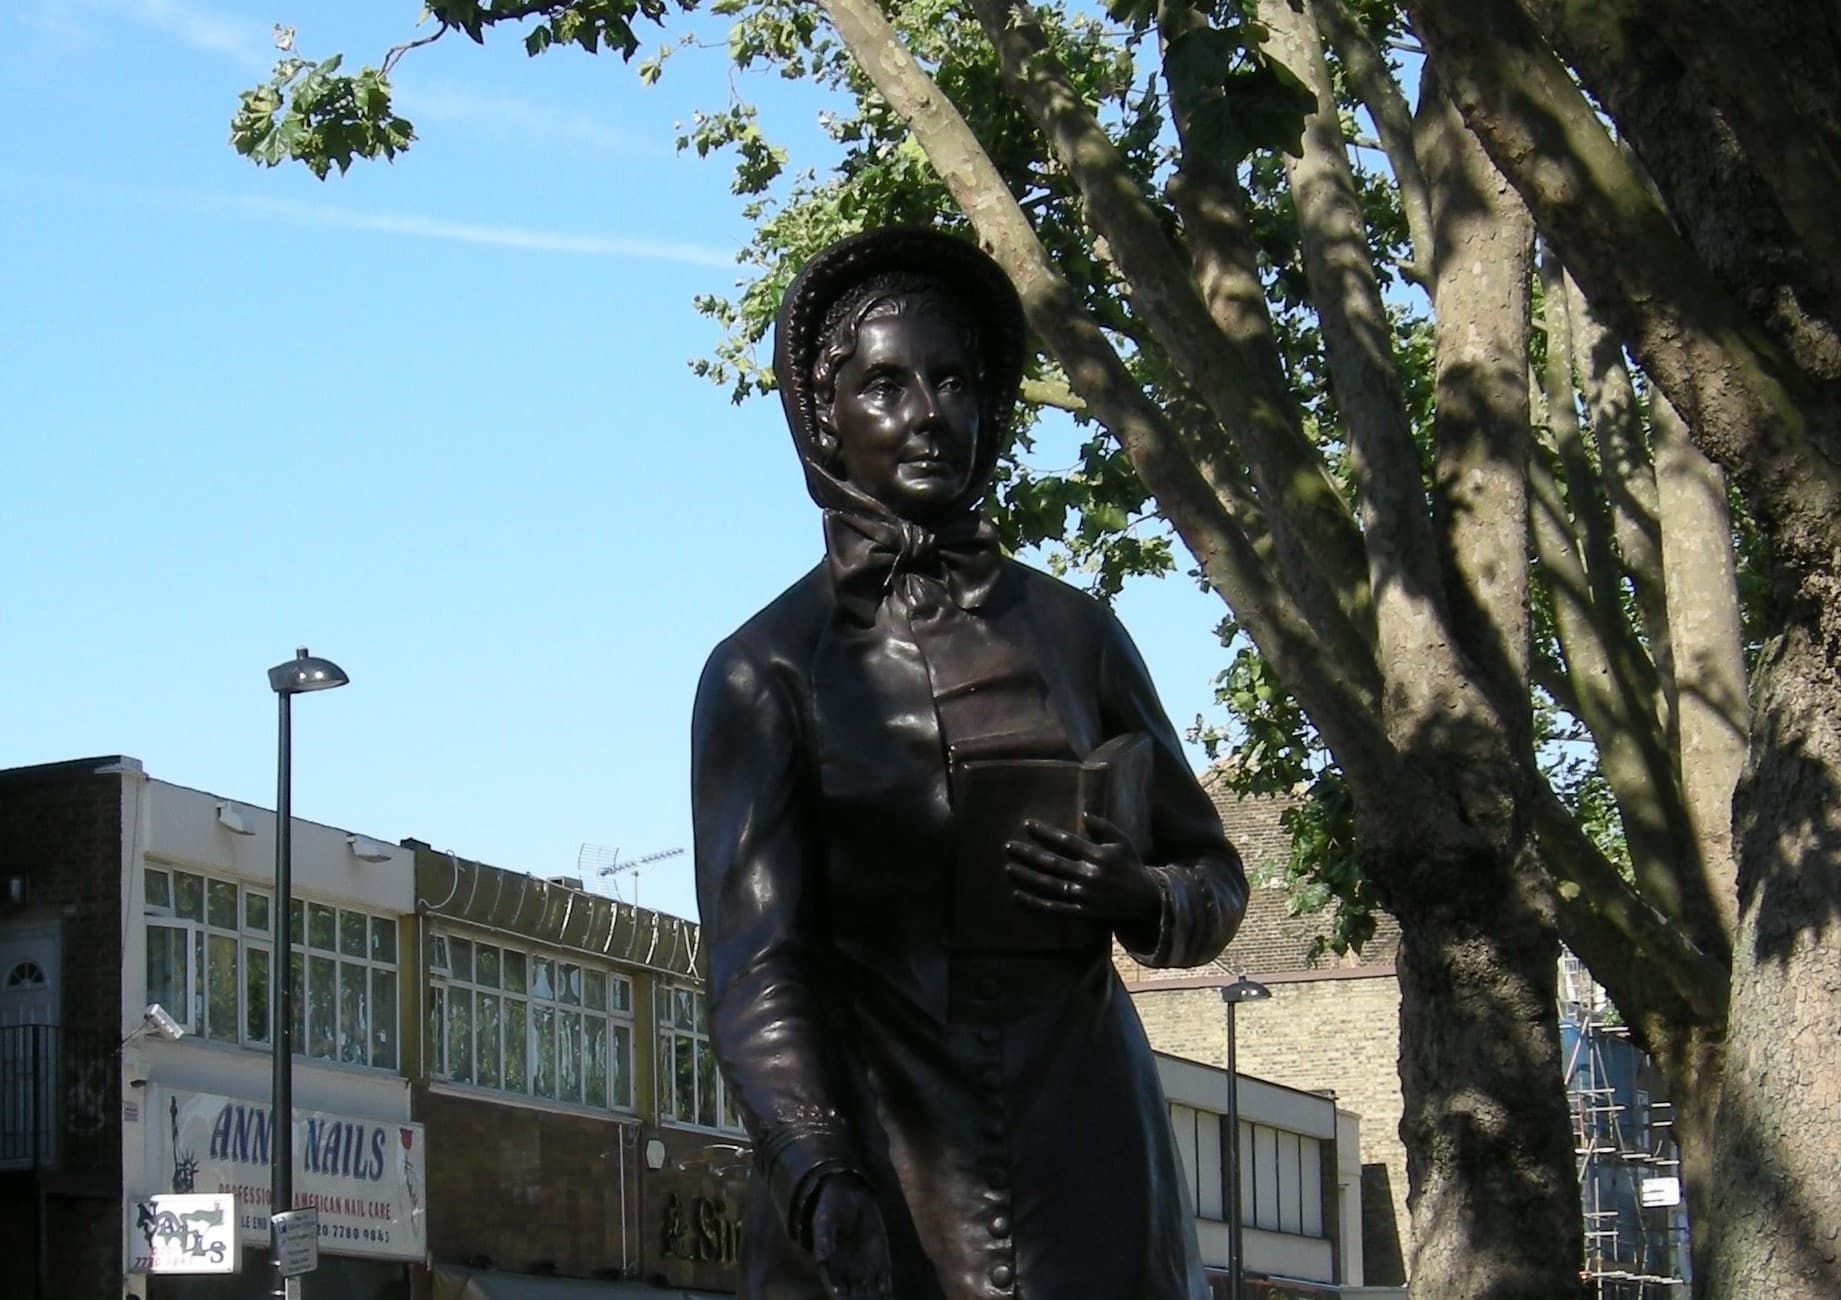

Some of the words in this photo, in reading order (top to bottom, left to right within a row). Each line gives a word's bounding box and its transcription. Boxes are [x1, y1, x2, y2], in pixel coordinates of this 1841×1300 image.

[304, 1117, 386, 1182] NAILS
[294, 1192, 342, 1215] AMERICAN
[344, 1197, 366, 1218] NAIL
[369, 1201, 391, 1221] CARE
[332, 1225, 359, 1241] 7780
